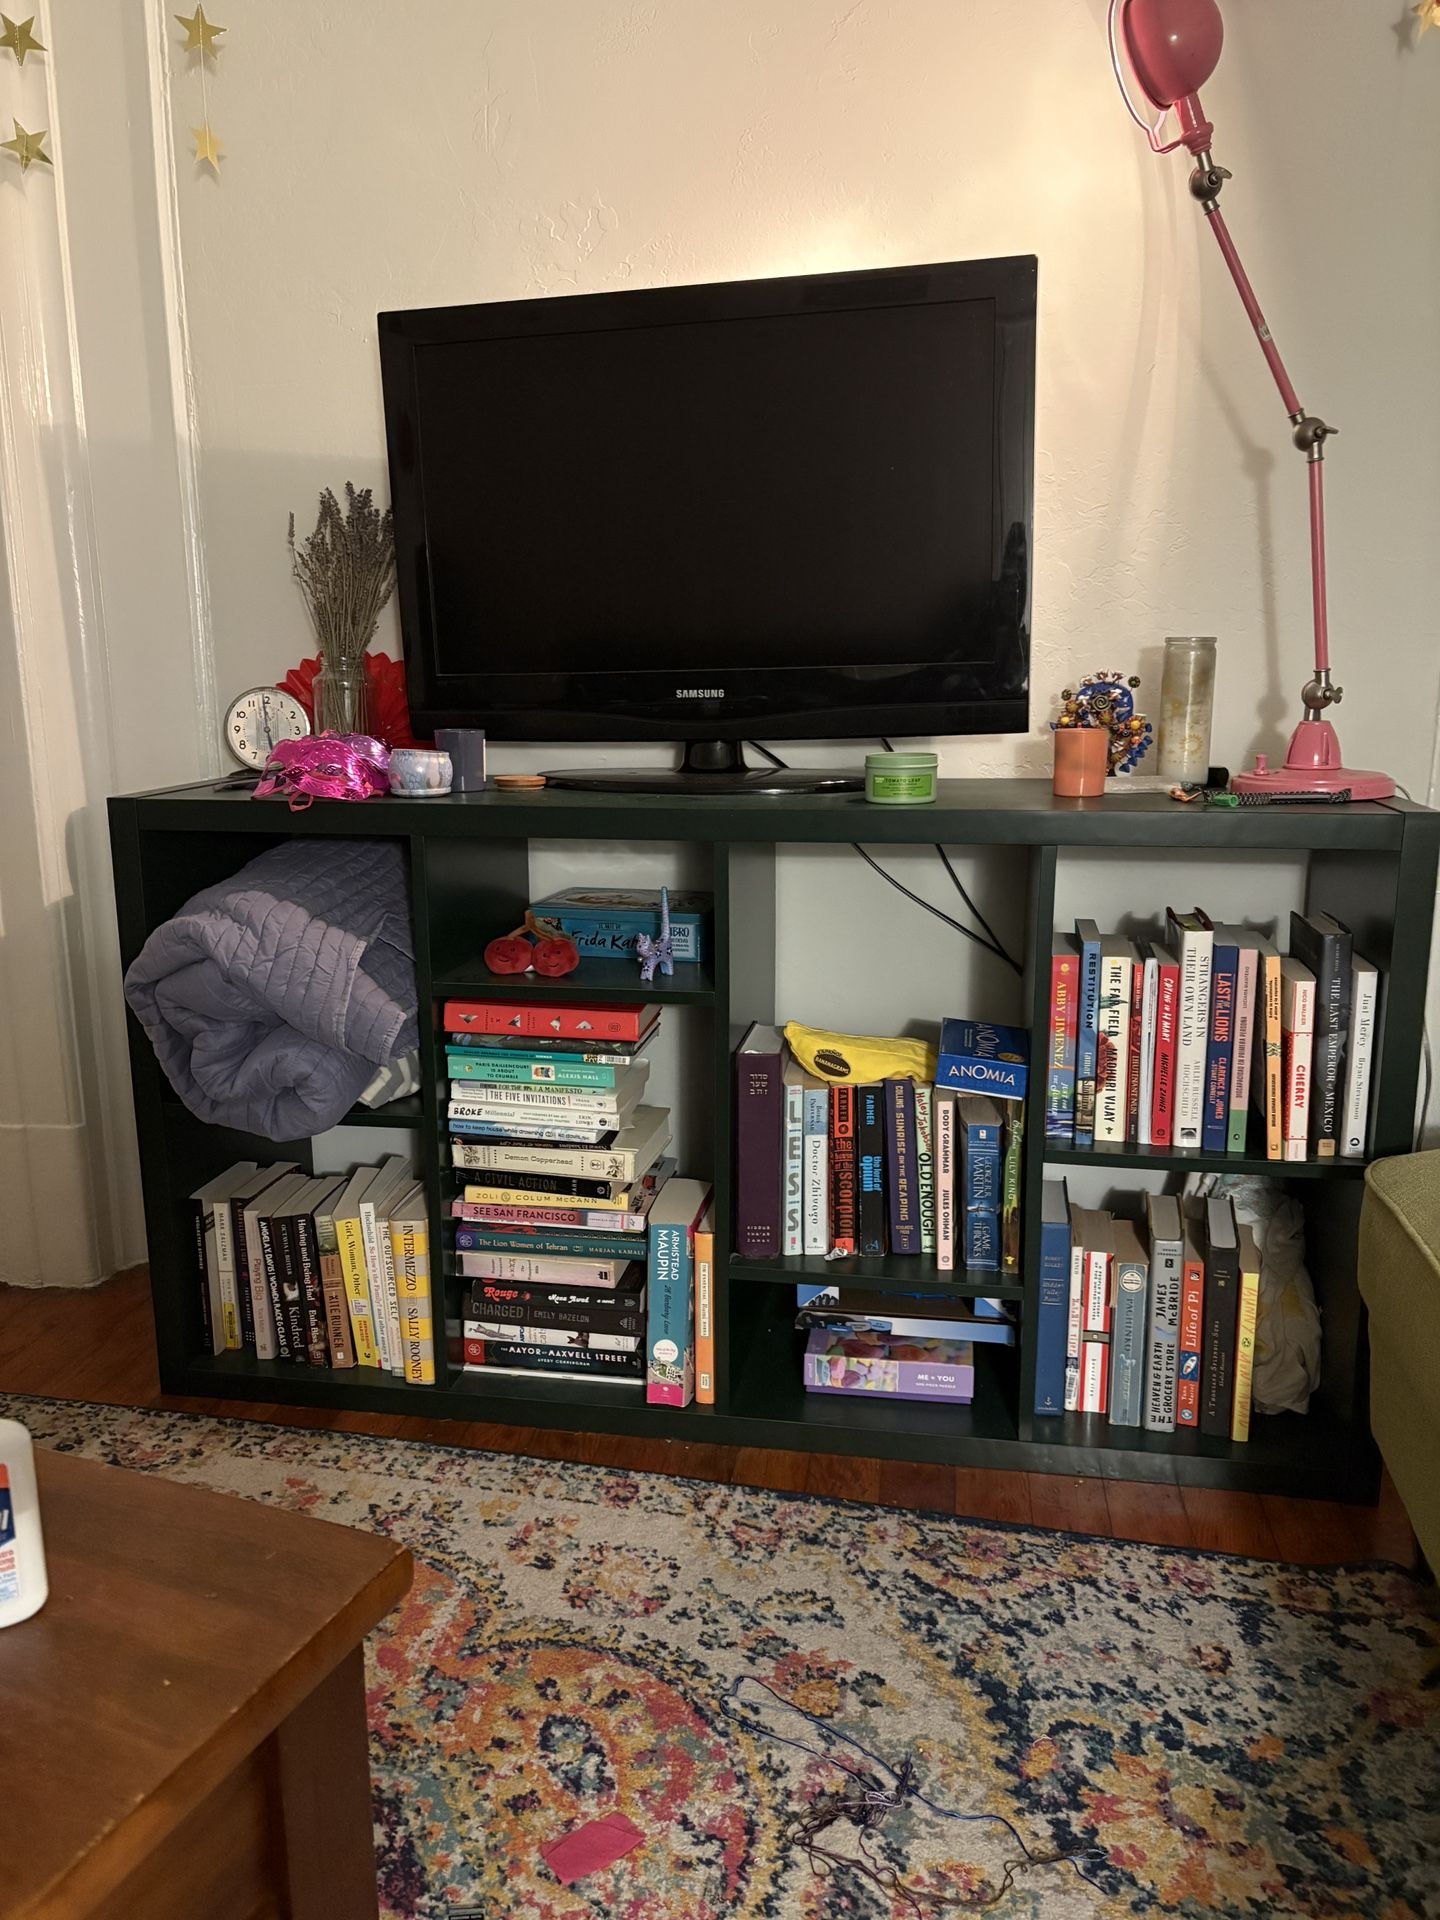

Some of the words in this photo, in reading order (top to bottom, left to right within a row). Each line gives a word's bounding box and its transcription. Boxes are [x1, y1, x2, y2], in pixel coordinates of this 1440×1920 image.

[676, 689, 725, 698] SAMSUNG
[236, 711, 246, 719] 10
[290, 711, 296, 719] 2
[234, 726, 241, 734] 9
[294, 726, 301, 735] 3
[239, 740, 247, 750] 8
[252, 752, 258, 760] 7
[572, 930, 606, 947] Frida
[1110, 966, 1122, 986] THE
[1185, 948, 1197, 983] THEIR
[1056, 982, 1066, 1016] ABBY
[1085, 953, 1097, 1029] RESTITUTION
[1163, 978, 1174, 1004] CRYING
[1184, 986, 1195, 1013] OWN
[1196, 956, 1210, 1023] STRANGERS
[1217, 973, 1233, 1004] LAST
[1330, 977, 1342, 1000] THE
[1363, 993, 1372, 1015] Just
[1108, 1010, 1120, 1037] FIELD
[1182, 1016, 1194, 1046] LAND
[1214, 1008, 1230, 1043] LIONS
[1329, 1003, 1340, 1033] LAST
[1054, 1018, 1066, 1069] JIMENEZ
[1162, 1022, 1172, 1043] MART
[1195, 1026, 1206, 1038] IN
[1357, 1019, 1371, 1048] Mercy
[816, 1056, 850, 1074] BANANAGRAMS
[1104, 1049, 1118, 1093] MADHURI
[1160, 1053, 1170, 1085] MICHELLE
[1326, 1036, 1339, 1083] EMPEROR
[948, 1064, 1015, 1086] ANOMIA
[1294, 1064, 1306, 1109] CHERRY
[454, 1107, 484, 1116] BROKE
[490, 1091, 503, 1100] THE
[505, 1092, 518, 1101] FIVE
[522, 1092, 567, 1106] INVITATIONS
[866, 1095, 875, 1126] FARMER
[916, 1092, 929, 1116] Haley
[1104, 1094, 1116, 1123] VIJAY
[1130, 1098, 1138, 1115] NUN
[1323, 1091, 1335, 1133] MEXICO
[519, 1129, 544, 1138] drowning
[896, 1112, 906, 1154] SUNRISE
[531, 1155, 573, 1165] Copperhead
[811, 1140, 821, 1177] Doctor
[919, 1153, 933, 1180] OLD
[1008, 1156, 1017, 1176] LILY
[475, 1172, 481, 1182] A
[485, 1172, 515, 1187] CIVIL
[518, 1177, 557, 1191] ACTION
[860, 1156, 873, 1192] opium
[973, 1156, 985, 1199] MARTIN
[516, 1194, 551, 1202] COLUM
[899, 1179, 909, 1221] REAPING
[1008, 1178, 1016, 1200] KING
[474, 1207, 492, 1216] SEE
[494, 1208, 514, 1217] SAN
[517, 1210, 576, 1222] FRANCISCO
[809, 1180, 822, 1225] Zhivago
[836, 1172, 854, 1238] scorpion
[920, 1184, 935, 1237] ENOUGH
[259, 1221, 270, 1248] ANGELA
[298, 1219, 307, 1247] Having
[364, 1211, 375, 1244] Hochschild
[302, 1248, 310, 1262] and
[403, 1225, 417, 1291] INTERMEZZO
[510, 1241, 534, 1249] Women
[546, 1242, 569, 1251] Tehran
[657, 1230, 669, 1281] MAUPIN
[671, 1230, 679, 1281] ARMISTEAD
[253, 1258, 262, 1284] Playing
[265, 1254, 274, 1272] DAVIS
[302, 1263, 312, 1284] Being
[384, 1245, 396, 1297] OUTSOURCED
[255, 1286, 264, 1301] Big
[306, 1285, 315, 1301] Had
[352, 1273, 361, 1297] Other
[484, 1287, 519, 1302] Rouge
[1188, 1291, 1199, 1304] Pi
[275, 1304, 284, 1321] RACE
[389, 1301, 399, 1321] SELF
[472, 1302, 524, 1318] CHARGED
[1156, 1284, 1168, 1319] JAMES
[1168, 1277, 1180, 1327] McBRIDE
[1190, 1307, 1199, 1321] of
[289, 1306, 305, 1349] Kindred
[408, 1308, 420, 1340] SALLY
[534, 1311, 556, 1320] EMILY
[558, 1313, 590, 1323] BAZELON
[1124, 1298, 1134, 1352] PACHINKO
[278, 1326, 287, 1346] CLASS
[312, 1327, 320, 1343] Biss
[331, 1314, 344, 1348] RUNNER
[1186, 1324, 1196, 1347] Life
[410, 1341, 423, 1383] ROONEY
[509, 1347, 541, 1355] MAYOR
[548, 1350, 592, 1360] MAXWELL
[595, 1354, 628, 1363] STREET
[1153, 1342, 1163, 1372] EARTH
[1165, 1343, 1175, 1373] STORE
[937, 1375, 955, 1383] YOU
[1152, 1380, 1162, 1414] HEAVEN
[1163, 1375, 1173, 1414] GROCERY
